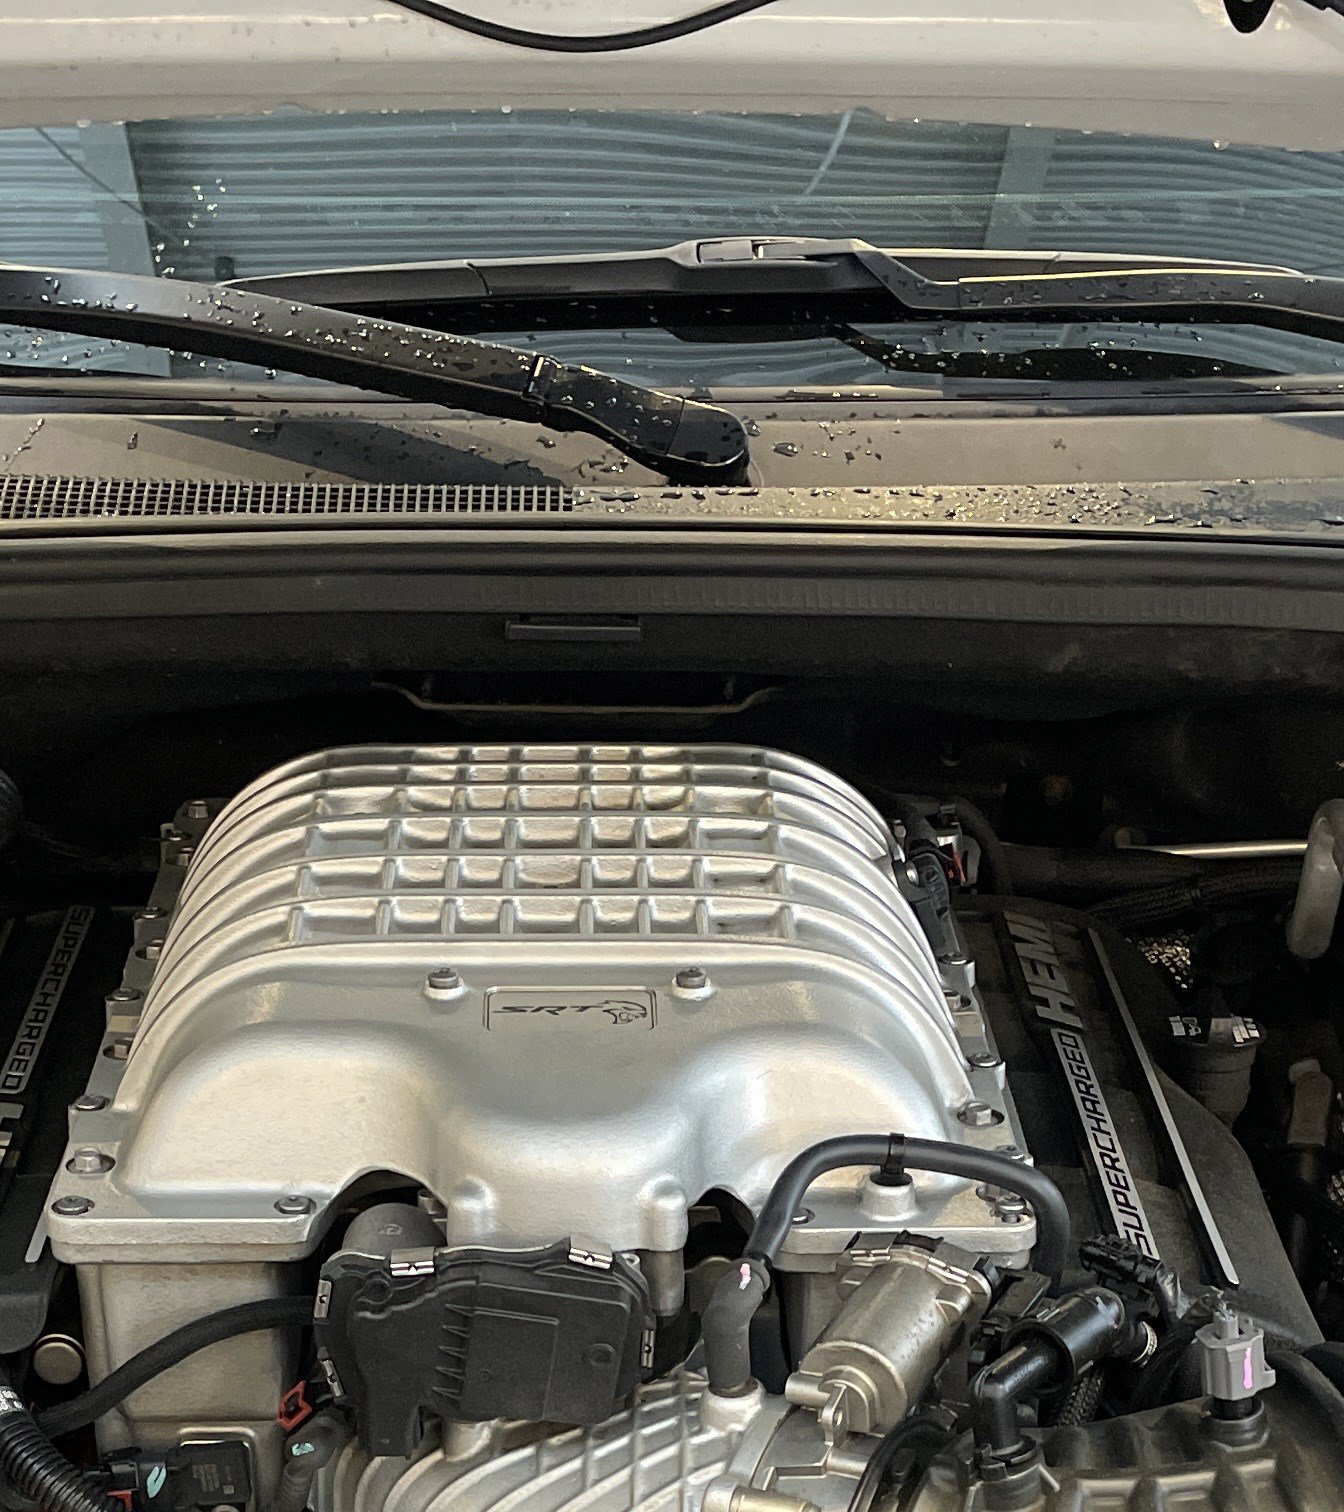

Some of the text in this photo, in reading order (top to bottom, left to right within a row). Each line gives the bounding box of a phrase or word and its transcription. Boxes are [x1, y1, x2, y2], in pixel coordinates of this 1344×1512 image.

[0, 905, 93, 1091] SUPERCHARGED
[493, 1005, 604, 1016] SRT
[1002, 909, 1084, 1029] HEMI
[1057, 1031, 1152, 1257] SUPERCHARGED
